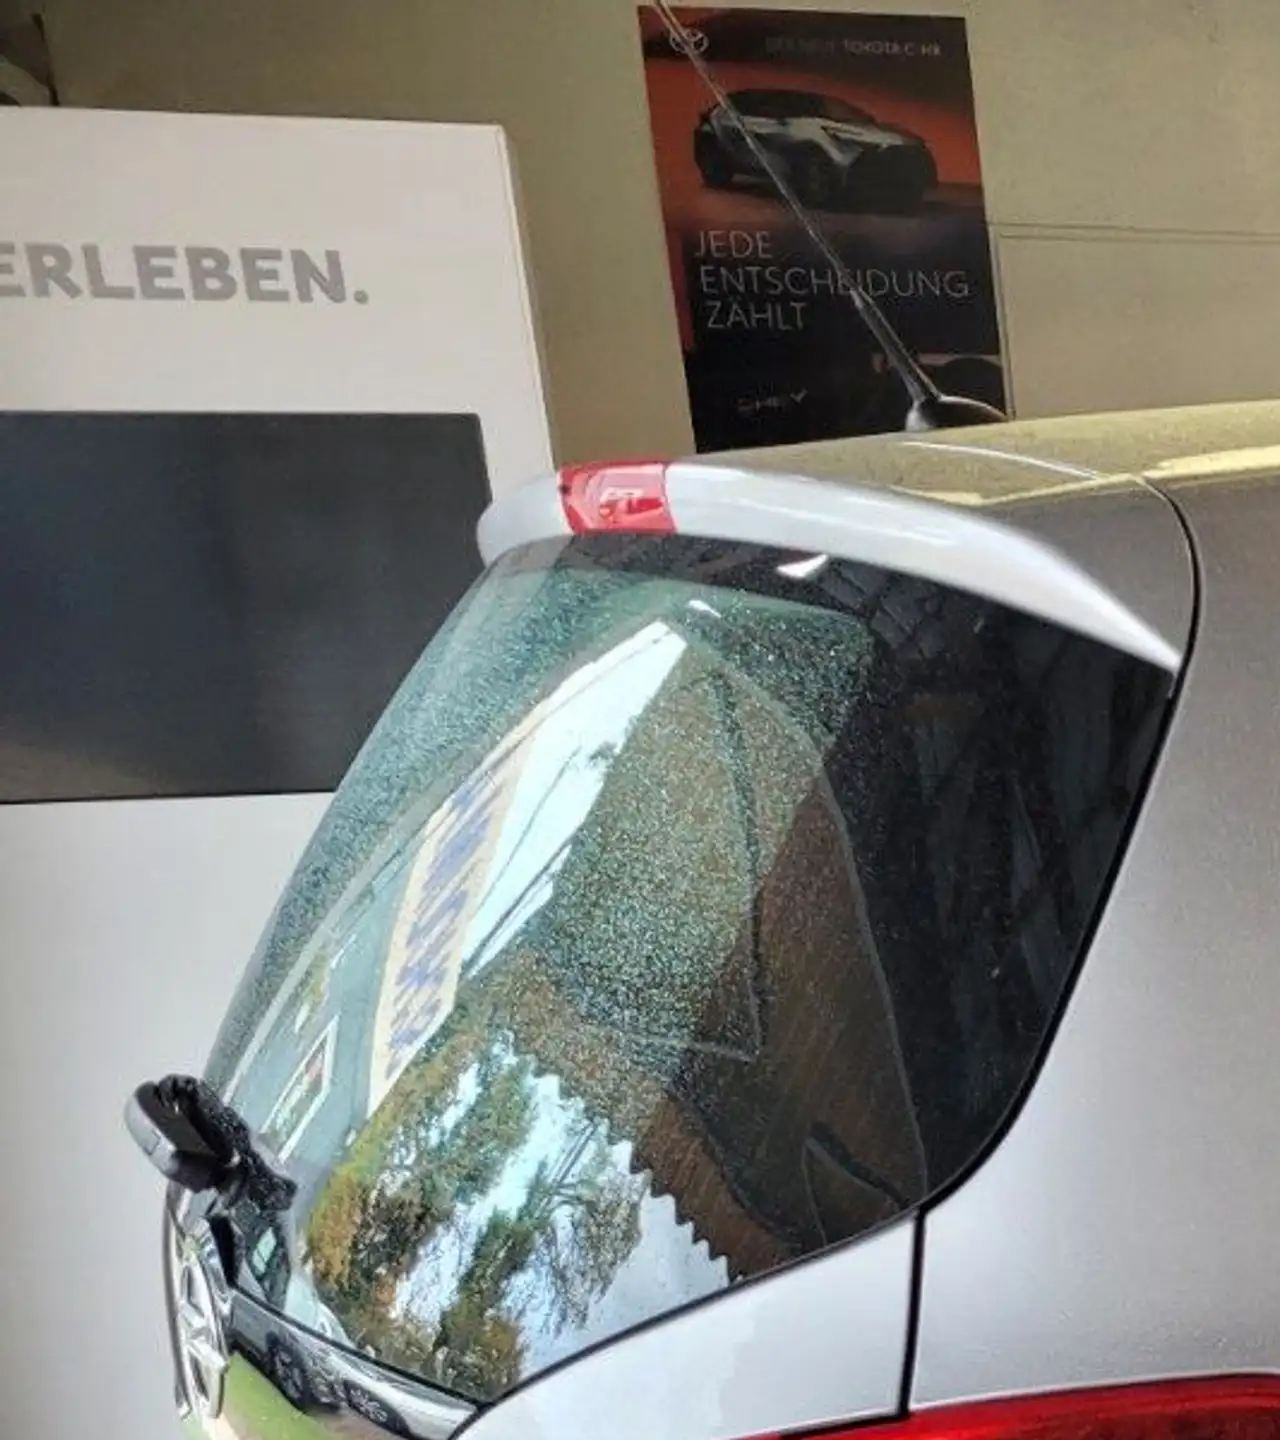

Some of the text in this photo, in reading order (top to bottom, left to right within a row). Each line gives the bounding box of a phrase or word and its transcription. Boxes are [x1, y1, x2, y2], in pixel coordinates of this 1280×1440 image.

[694, 229, 774, 260] JEDE
[700, 265, 971, 299] ENTSCHEIDUNG
[706, 296, 807, 331] ZÄHLT
